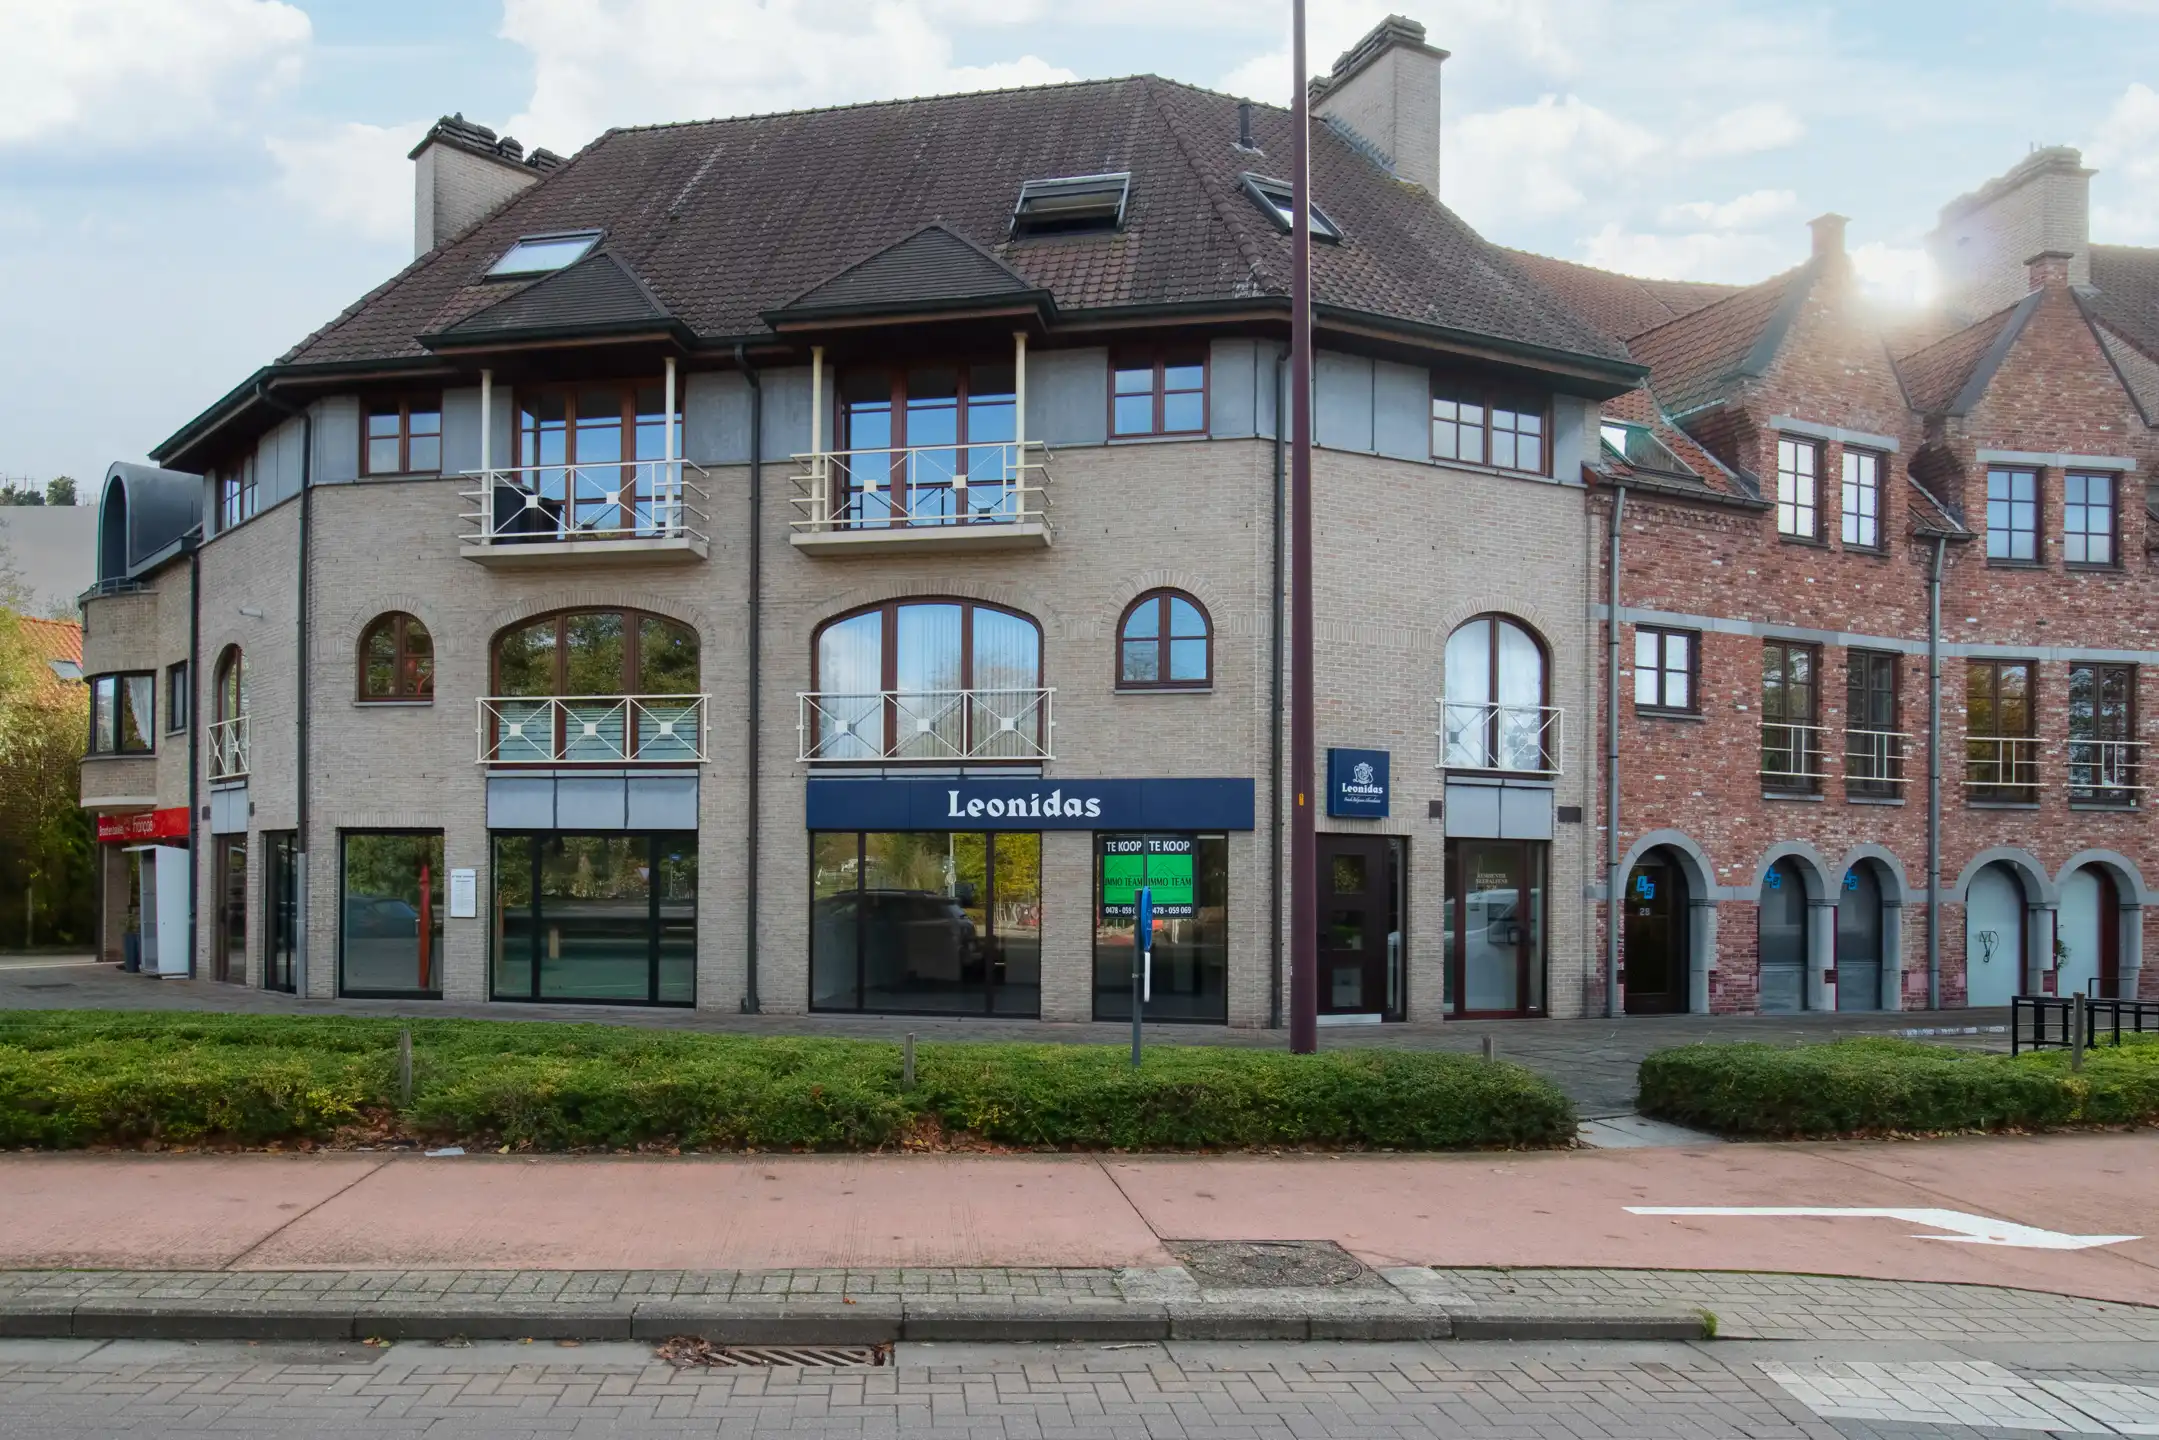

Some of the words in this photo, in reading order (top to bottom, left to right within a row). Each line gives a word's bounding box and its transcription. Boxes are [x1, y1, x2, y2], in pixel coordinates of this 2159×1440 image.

[1342, 783, 1383, 794] Leonidas
[948, 788, 1101, 818] Leonidas
[1106, 842, 1117, 852] TE
[1118, 841, 1142, 852] KOOP
[1149, 841, 1160, 851] TE
[1163, 841, 1190, 851] KOOP
[1104, 878, 1123, 886] IMMO
[1125, 878, 1143, 886] TEAM
[1148, 878, 1169, 886] IMMO
[1171, 878, 1192, 886] TEAM
[1105, 906, 1118, 914] 0478
[1168, 906, 1180, 914] 059
[1180, 906, 1192, 914] 069
